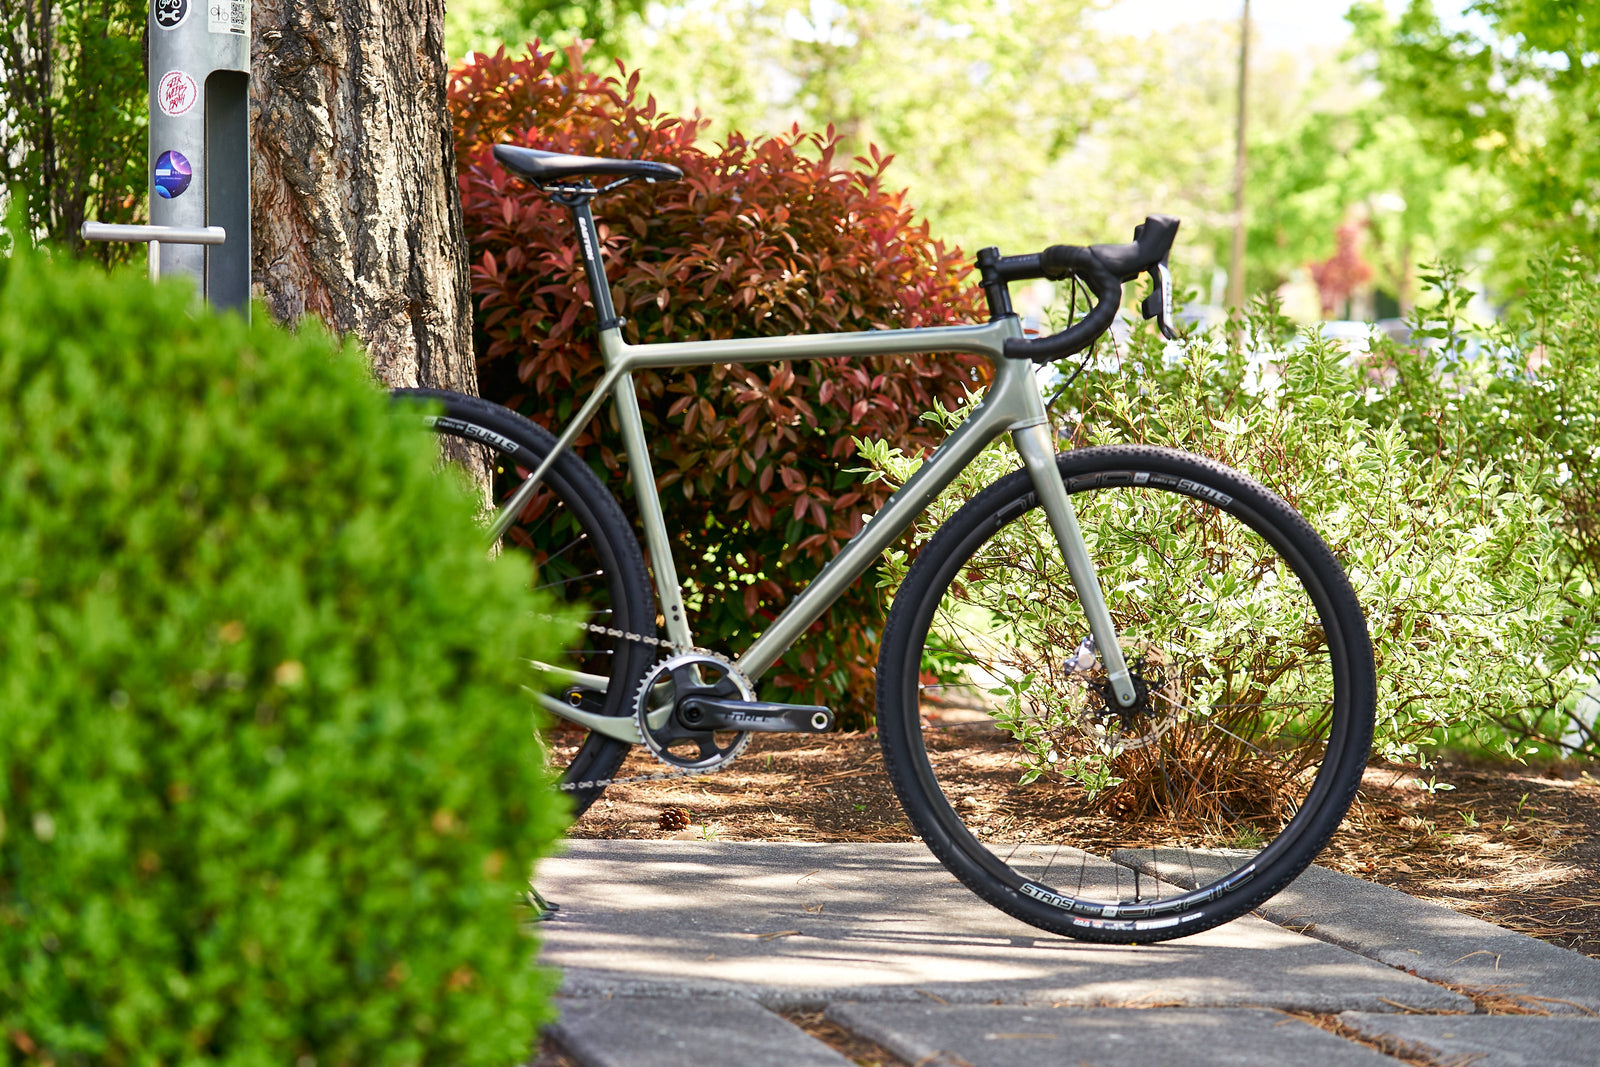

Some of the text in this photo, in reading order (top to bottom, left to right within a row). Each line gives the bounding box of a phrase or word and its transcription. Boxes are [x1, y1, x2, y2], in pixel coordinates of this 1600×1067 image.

[466, 425, 517, 452] STANS
[1178, 479, 1232, 505] STANS
[1020, 883, 1074, 909] STANS
